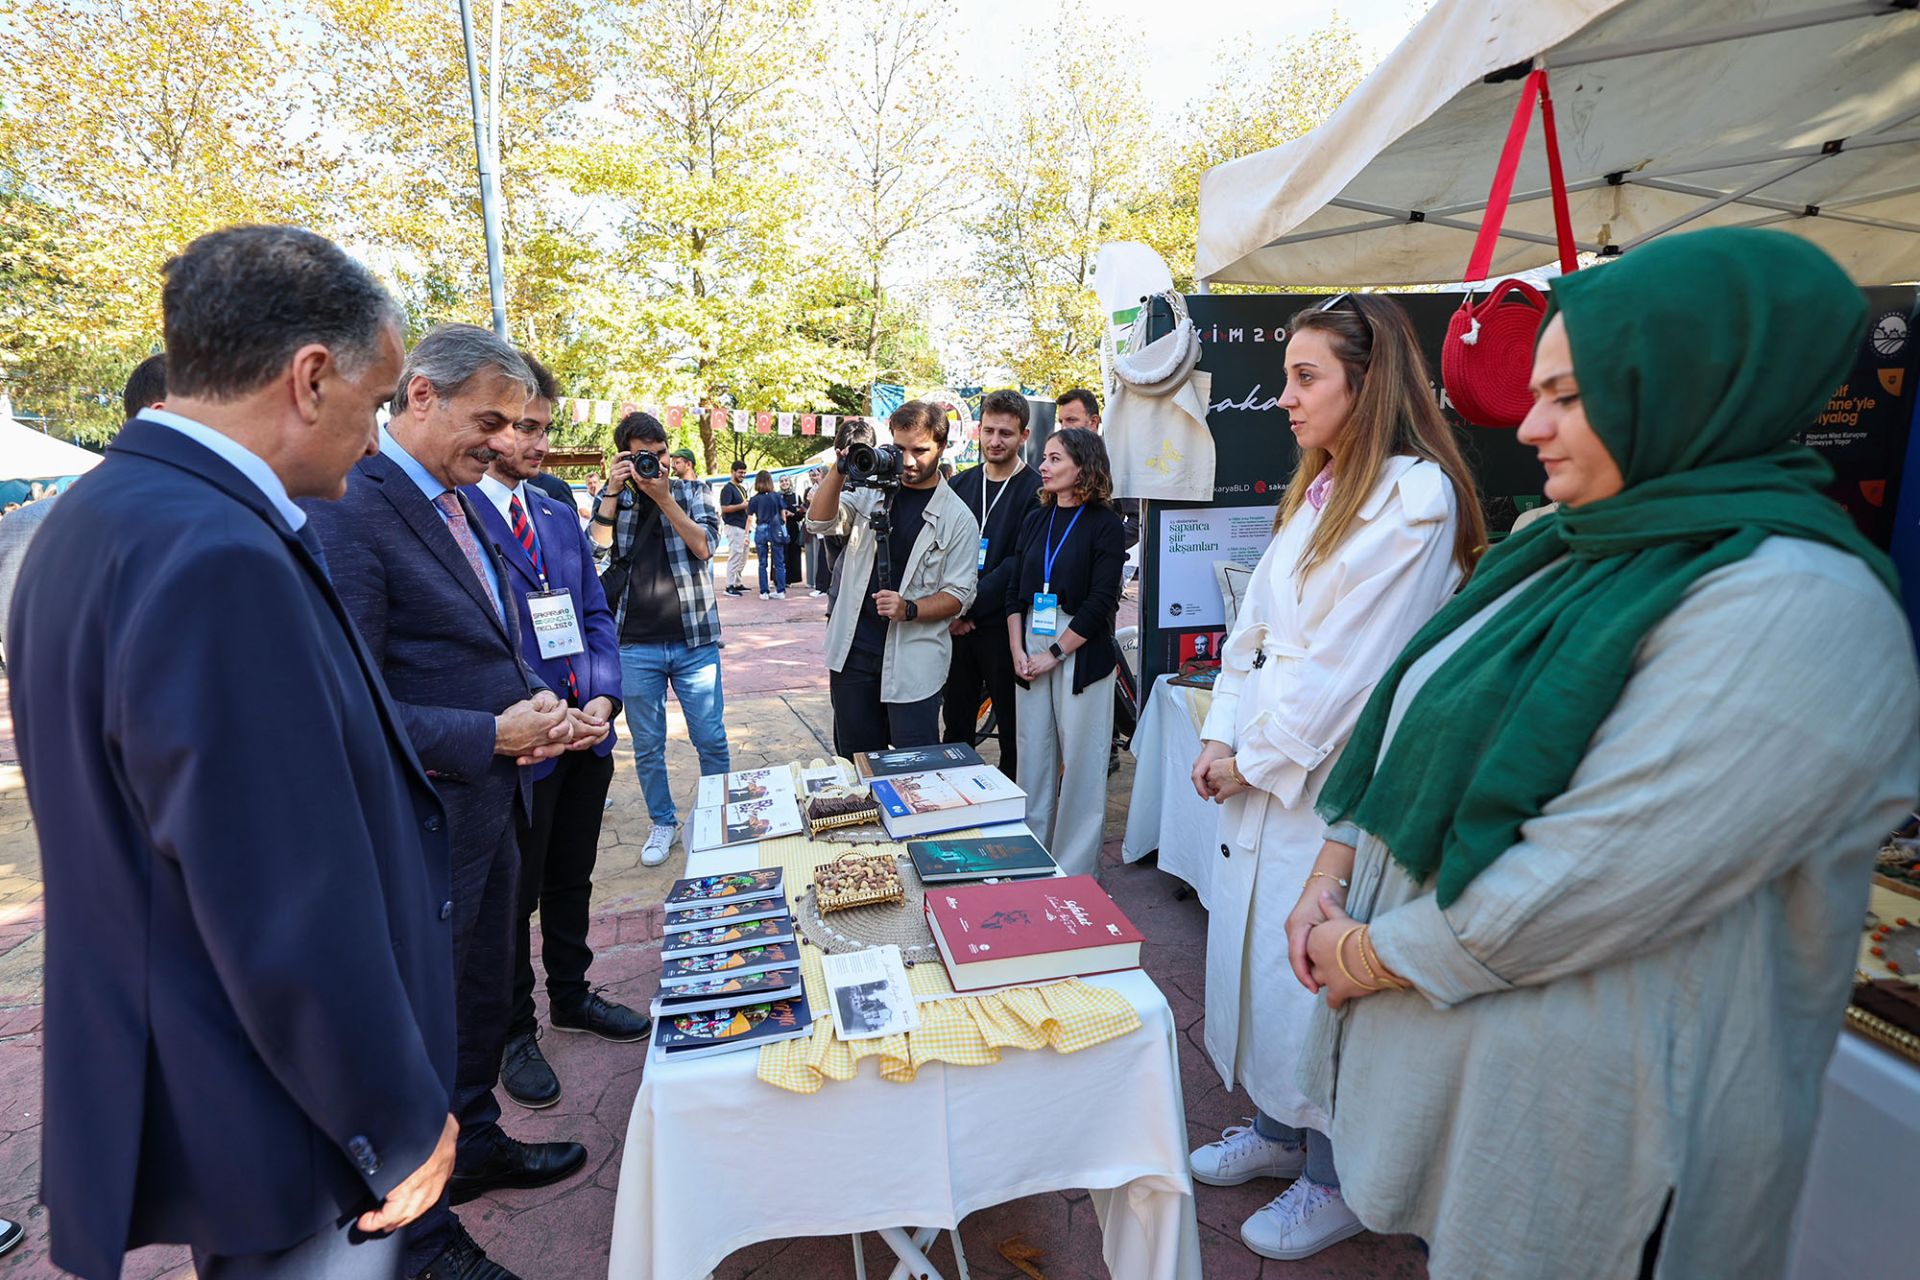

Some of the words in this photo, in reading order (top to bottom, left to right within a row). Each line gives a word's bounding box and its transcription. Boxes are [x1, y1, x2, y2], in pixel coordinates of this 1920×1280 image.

[1253, 327, 1287, 343] 20
[1815, 411, 1858, 426] iyalog
[1214, 484, 1250, 493] karyaBLD
[1268, 483, 1290, 491] sakar
[1169, 522, 1210, 533] sapanca
[1169, 541, 1219, 554] akşamları
